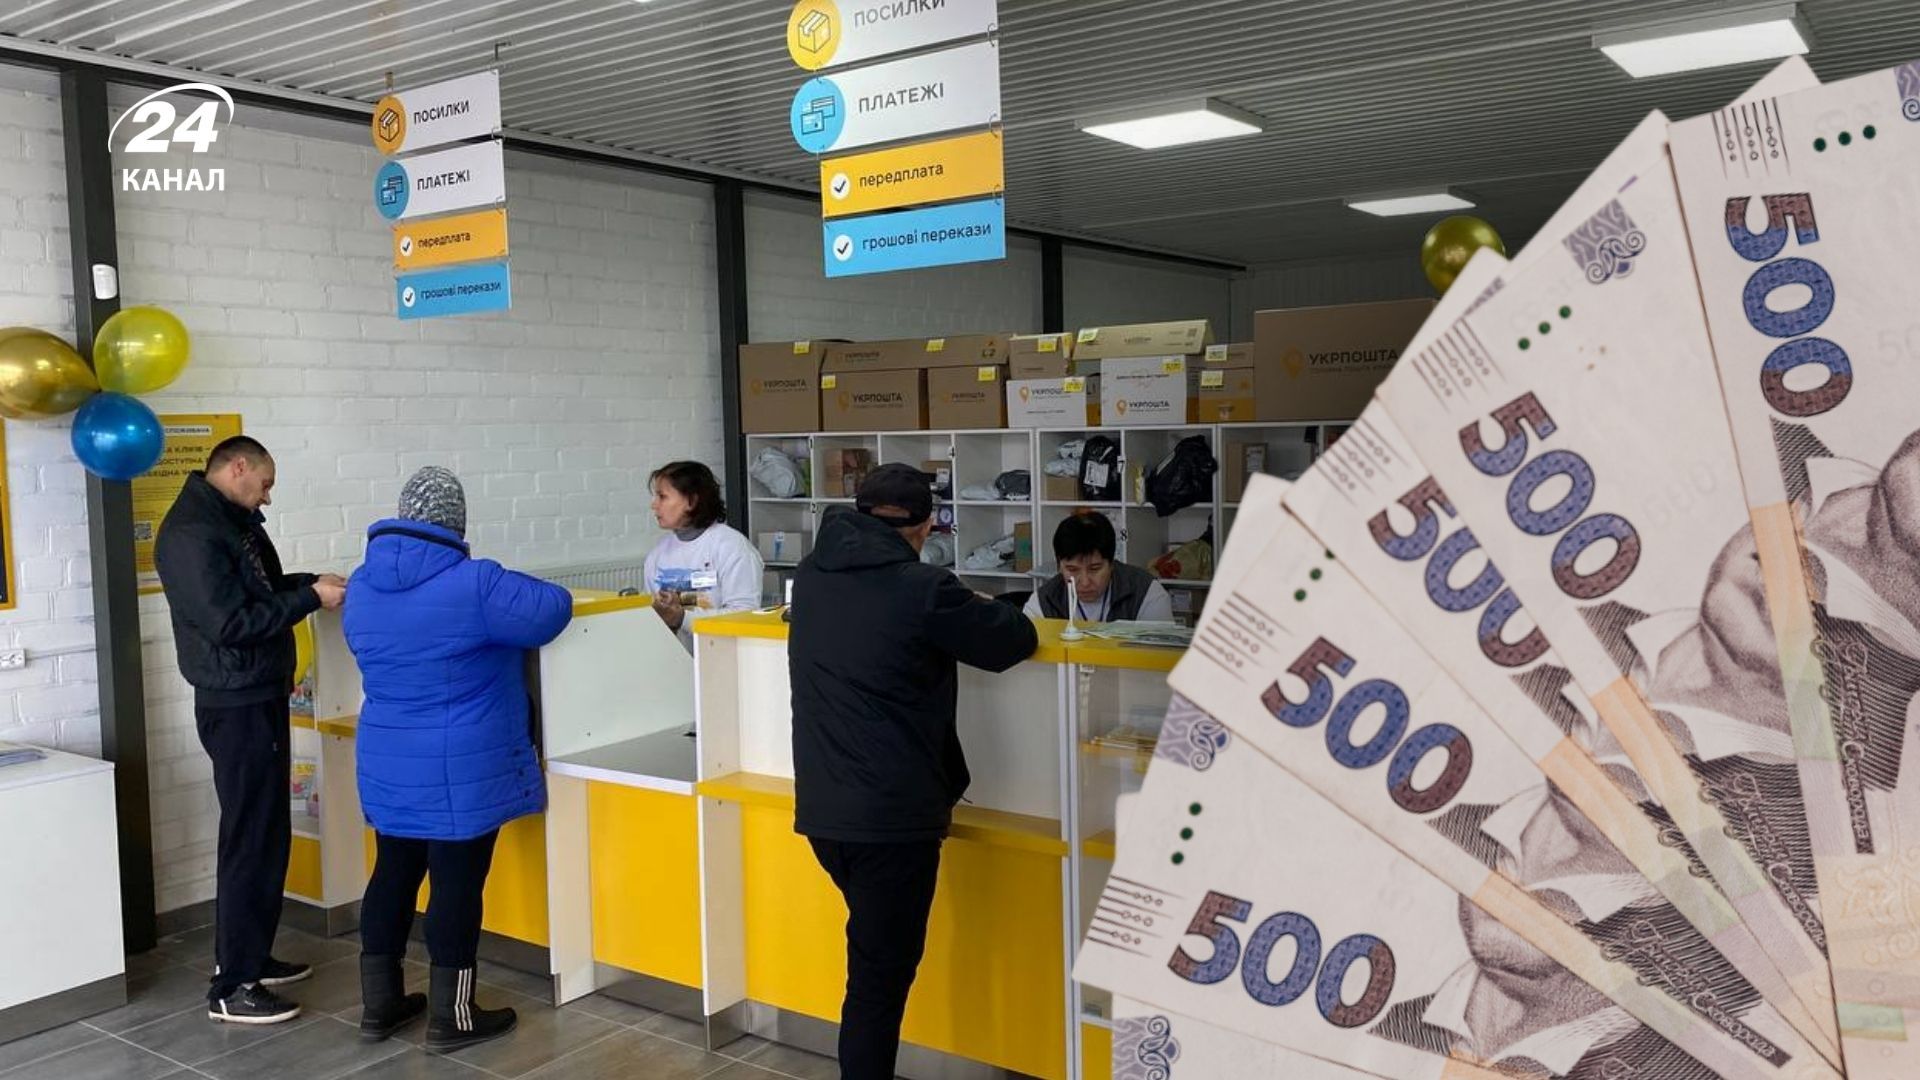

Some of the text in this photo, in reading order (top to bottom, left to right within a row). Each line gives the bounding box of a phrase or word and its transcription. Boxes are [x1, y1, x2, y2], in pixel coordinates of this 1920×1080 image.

[858, 82, 944, 113] ПЛАТЕЖІ
[413, 100, 470, 125] ПОСИЛКИ
[417, 169, 471, 191] ПЛАТЕЖІ
[859, 163, 944, 188] передплата
[417, 231, 471, 250] передплата
[862, 223, 992, 252] грошові перекази
[420, 280, 501, 300] грошові перекази
[1724, 191, 1853, 417] 500
[1308, 349, 1399, 365] УКРПОШТА
[763, 379, 807, 389] УКРПОШТА
[852, 392, 903, 403] УКРПОШТА
[1129, 400, 1170, 409] УКРПОШТА
[1458, 391, 1641, 601] 500
[1120, 528, 1127, 541] 8
[1260, 636, 1473, 814] 500
[1167, 889, 1396, 1029] 500
